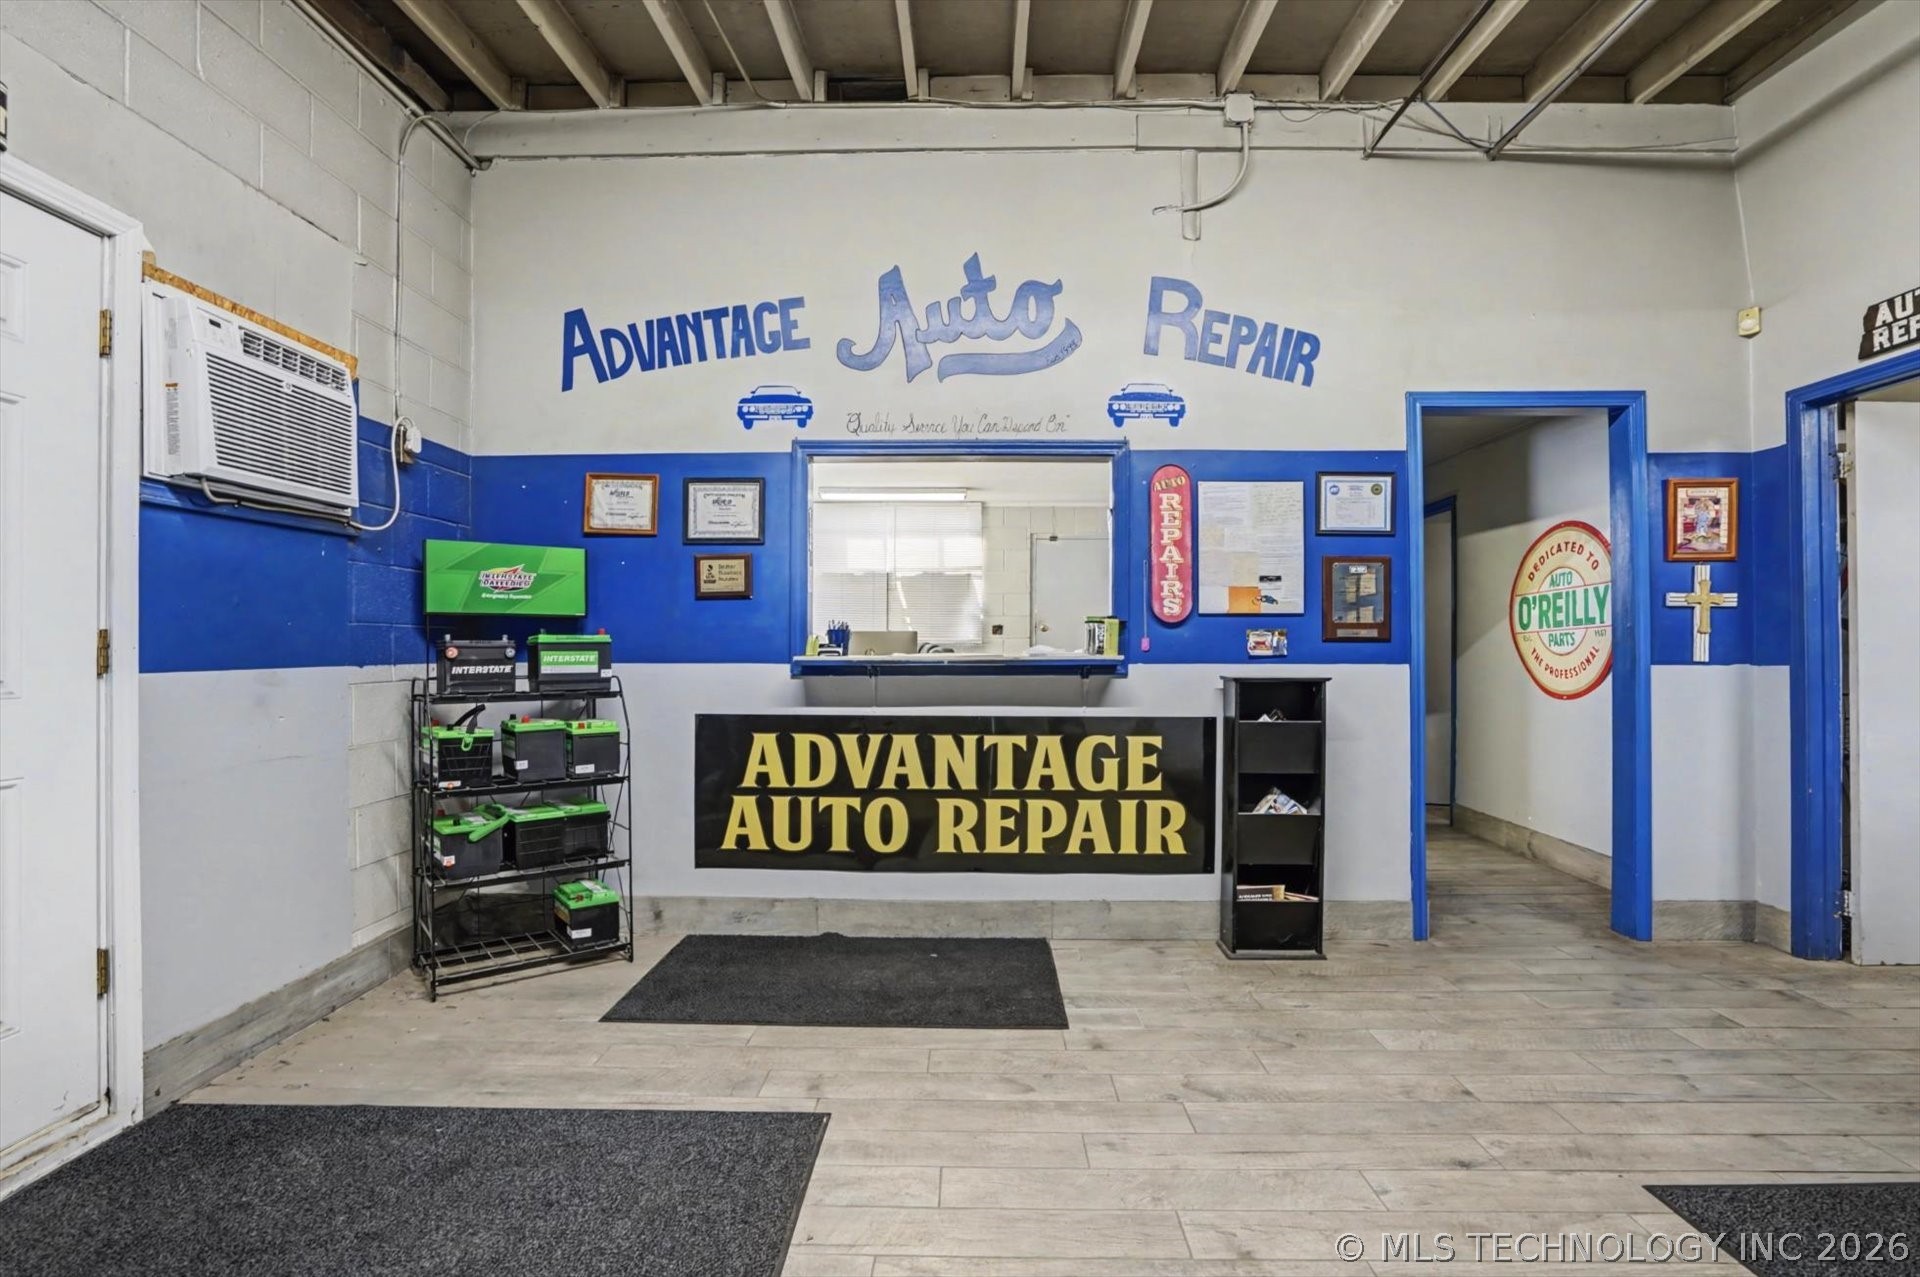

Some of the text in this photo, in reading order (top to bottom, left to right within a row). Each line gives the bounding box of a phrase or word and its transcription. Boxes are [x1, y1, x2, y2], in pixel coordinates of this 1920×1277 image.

[561, 252, 1321, 392] ADVANTAGE Auto REPAIR
[1875, 288, 1920, 327] AU
[1153, 476, 1185, 492] AUTO
[1159, 493, 1184, 616] REPAIRS
[1527, 541, 1599, 582] DEDICATED TO
[1549, 571, 1573, 588] AUTO
[1518, 584, 1609, 631] O'REILLY
[543, 654, 597, 663] INTERSTATE
[1548, 632, 1575, 647] PARTS
[451, 665, 514, 674] INTERSTATE
[1531, 646, 1599, 679] THE PROFESSIONAL
[736, 731, 1164, 793] ADVANTAGE
[719, 794, 1190, 856] AUTO REPAIR
